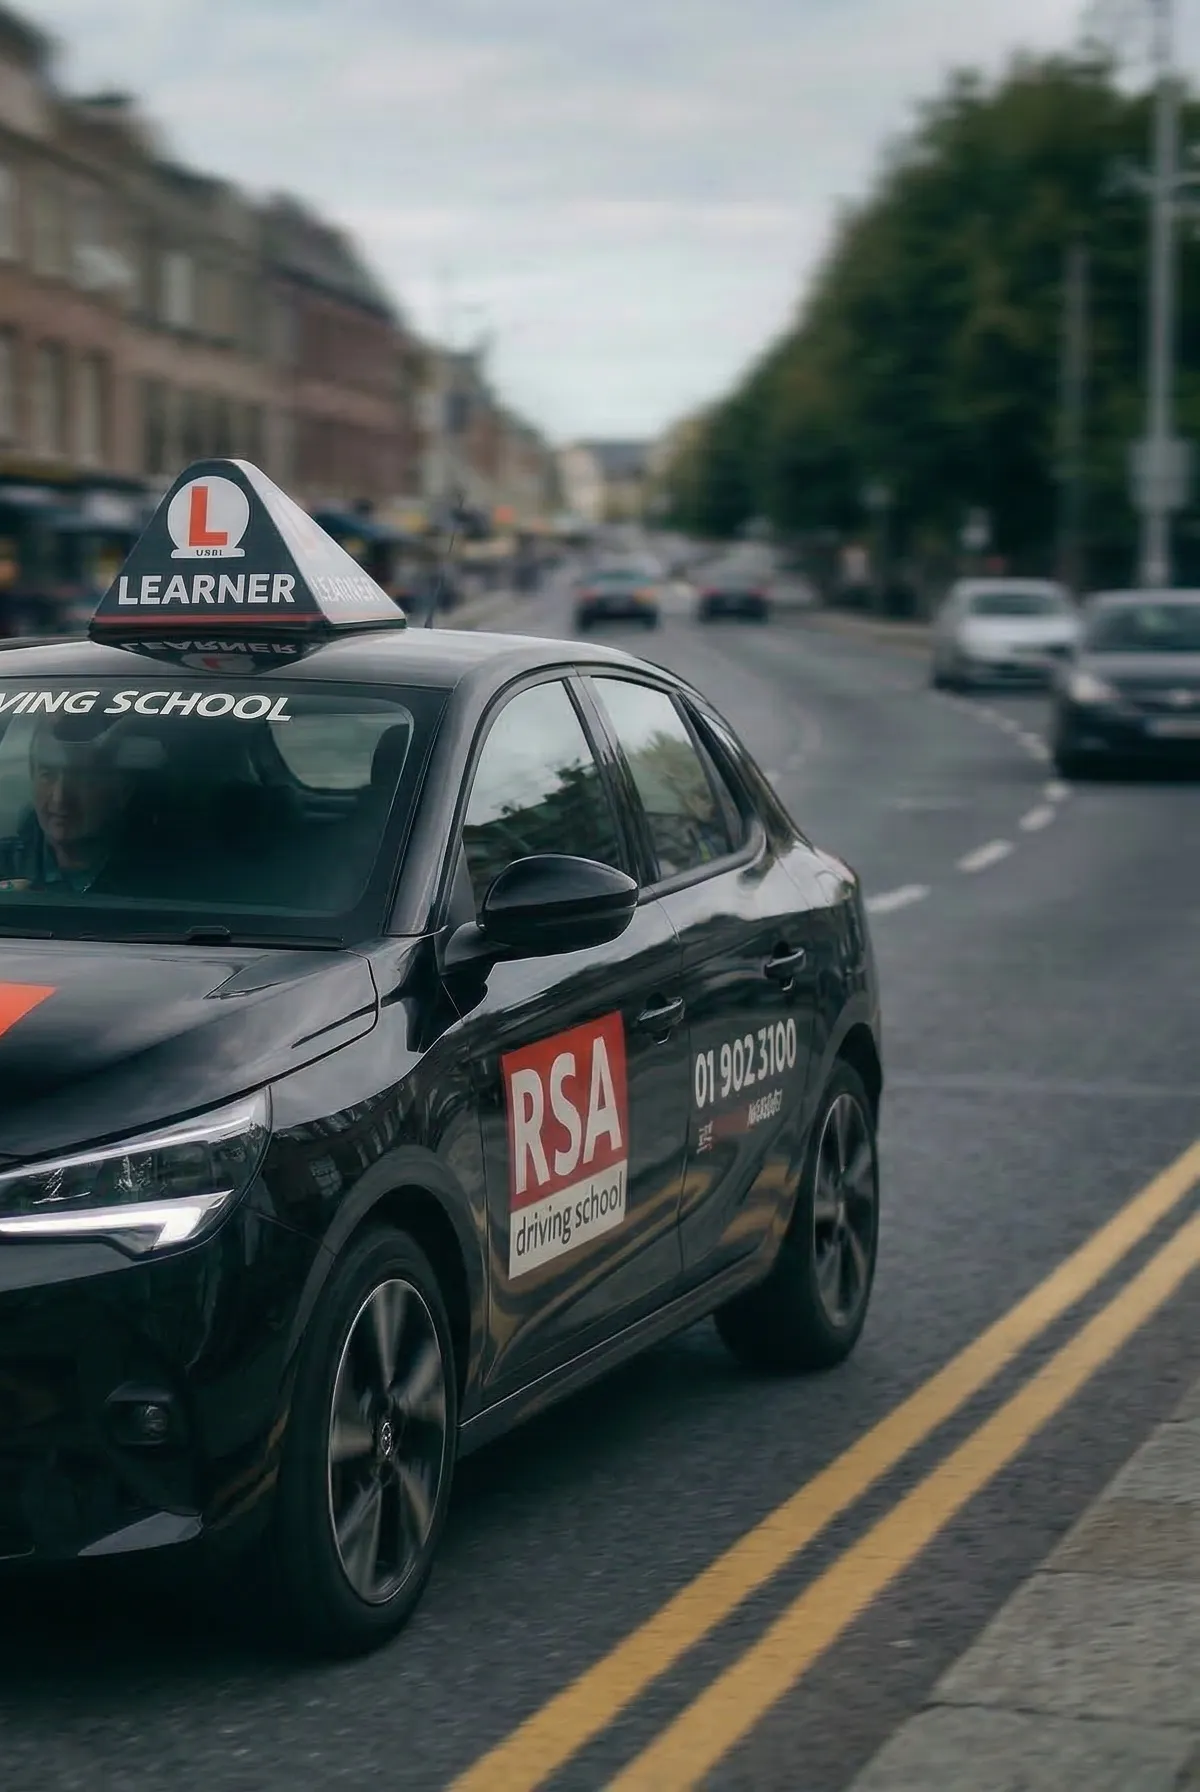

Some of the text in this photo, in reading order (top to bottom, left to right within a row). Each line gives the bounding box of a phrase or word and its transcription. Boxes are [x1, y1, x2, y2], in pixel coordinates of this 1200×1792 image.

[188, 485, 228, 547] L
[118, 574, 296, 605] LEARNER
[104, 690, 293, 722] SCHOOL
[695, 1050, 714, 1108] 01
[720, 1034, 756, 1098] 902
[757, 1018, 797, 1081] 3100
[511, 1036, 623, 1195] RSA
[516, 1171, 623, 1256] driving school
